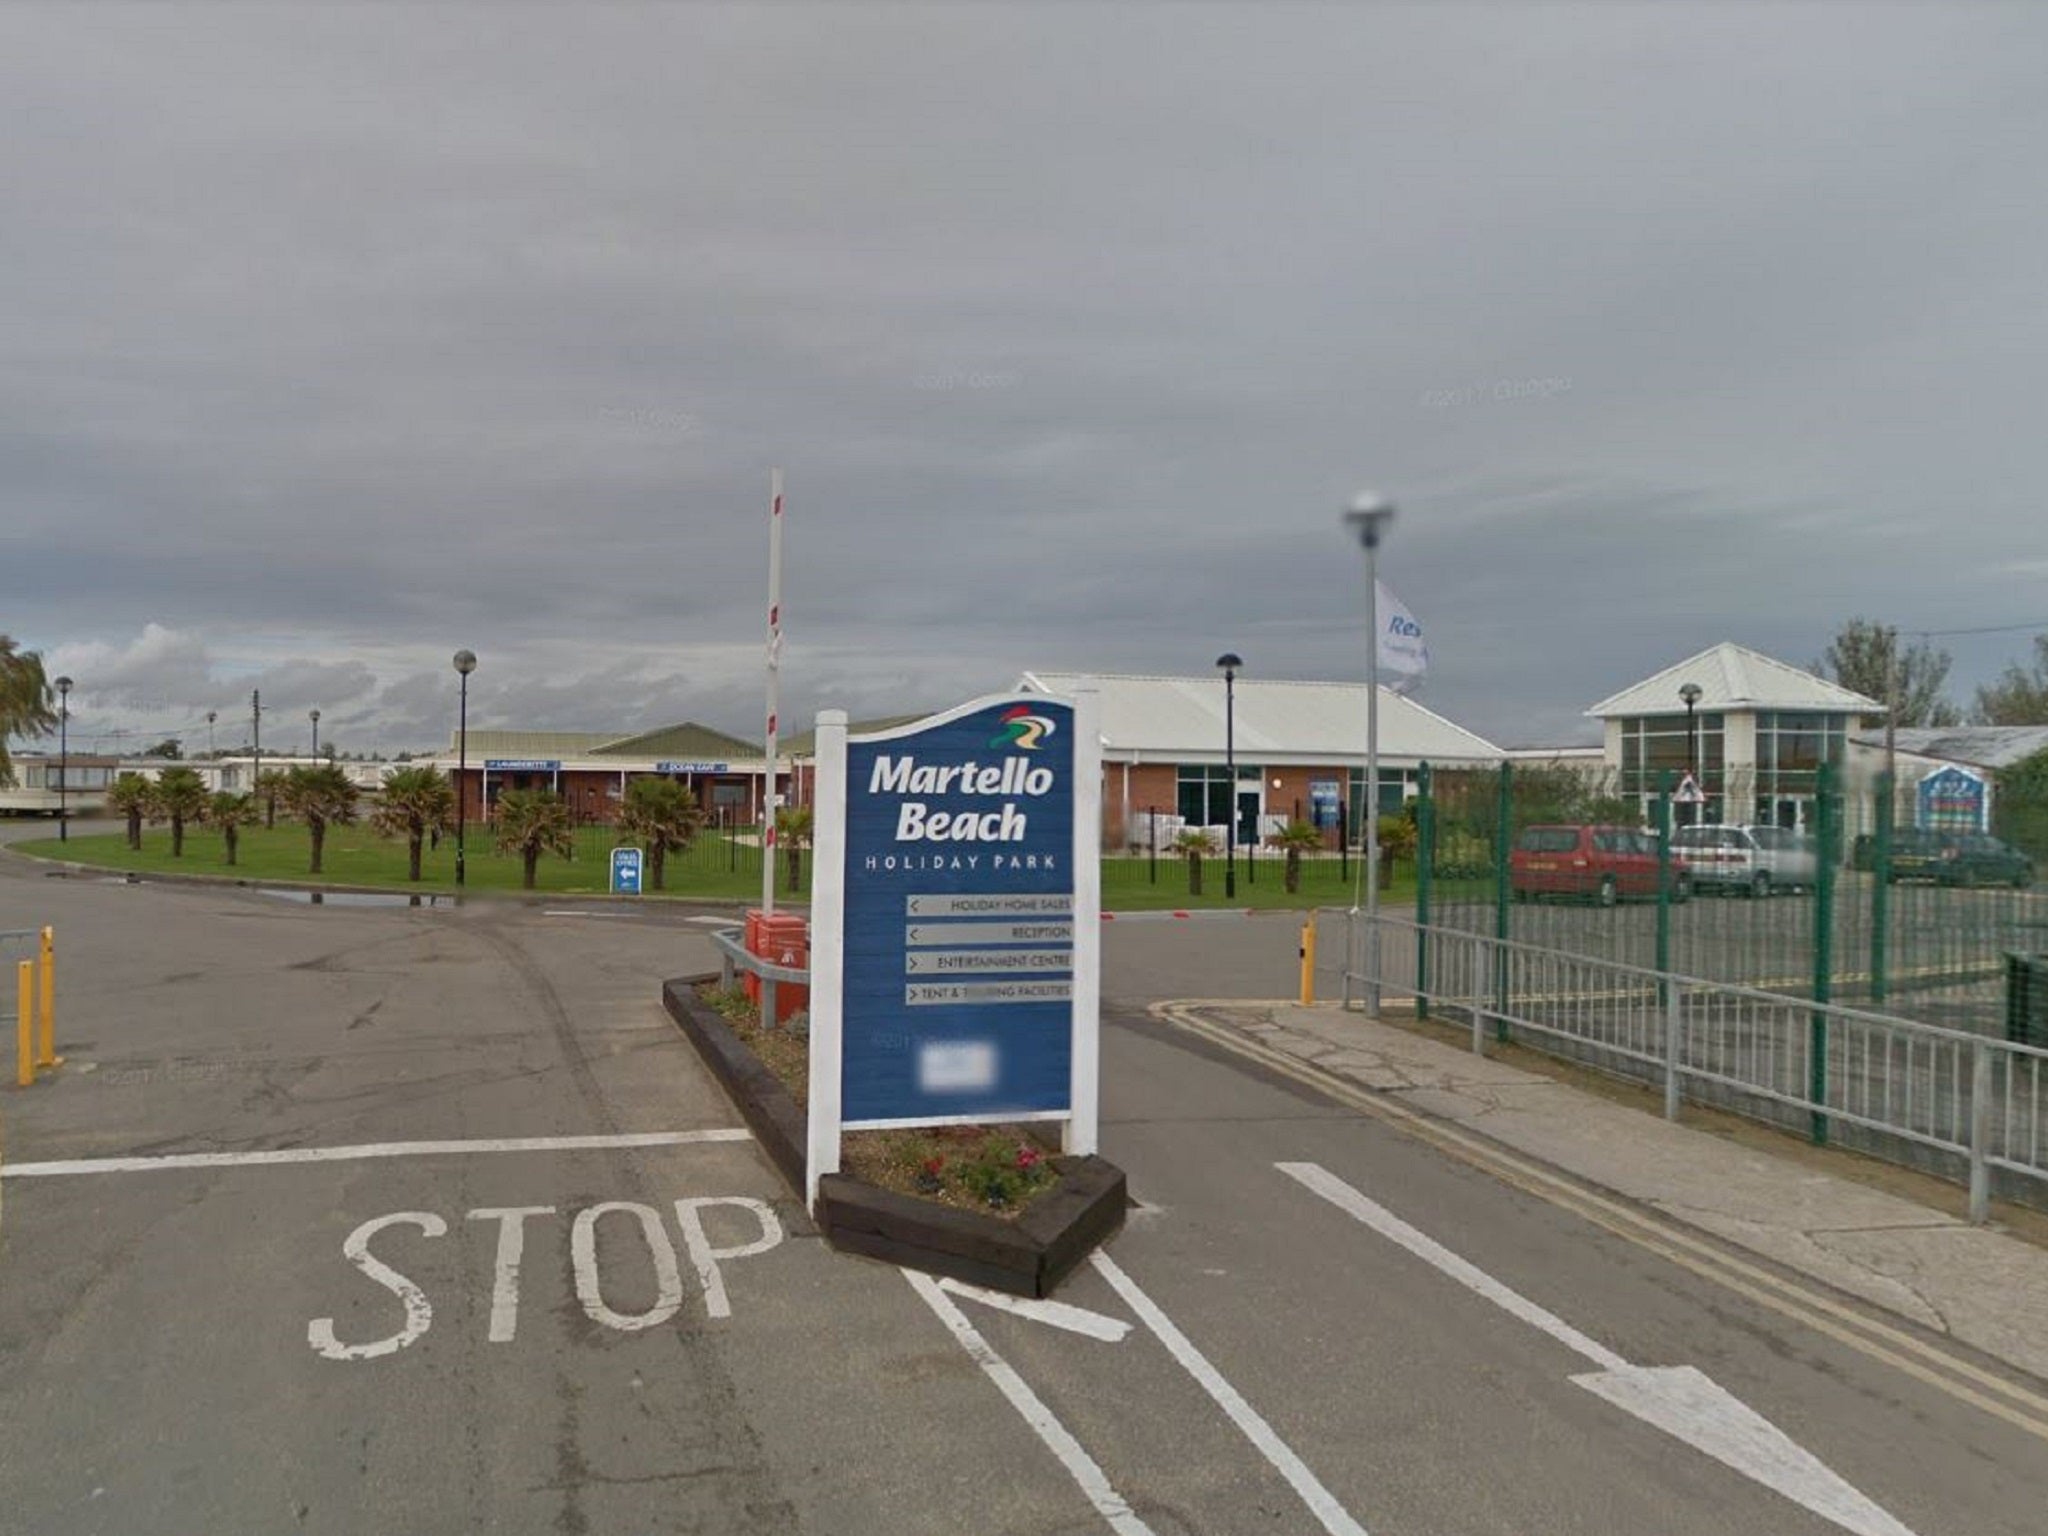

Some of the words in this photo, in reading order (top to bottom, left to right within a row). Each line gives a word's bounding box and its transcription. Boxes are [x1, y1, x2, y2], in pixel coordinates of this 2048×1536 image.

[869, 755, 1054, 795] Martello
[895, 803, 1027, 841] Beach
[866, 855, 978, 869] HOLIDAY
[994, 855, 1054, 868] PARK
[951, 900, 999, 910] HOLIDAY
[1005, 900, 1036, 910] HOME
[1041, 899, 1070, 909] SALES
[1012, 927, 1070, 938] RECEPTION
[938, 956, 1026, 968] ENTERTAINMENT
[1030, 954, 1070, 966] CENTRE
[1018, 984, 1070, 996] FACILITIES
[308, 1197, 783, 1360] STOP
